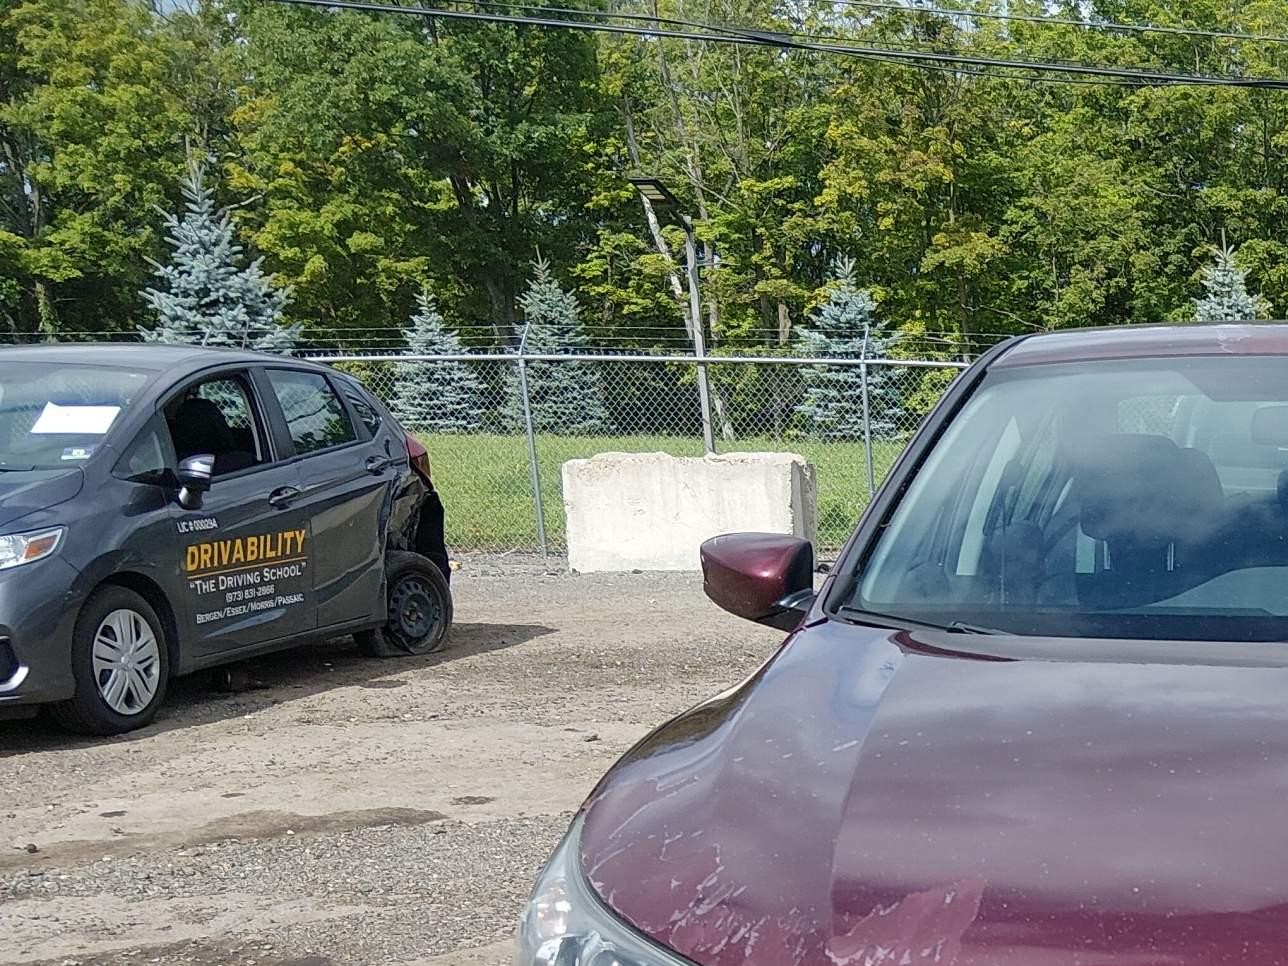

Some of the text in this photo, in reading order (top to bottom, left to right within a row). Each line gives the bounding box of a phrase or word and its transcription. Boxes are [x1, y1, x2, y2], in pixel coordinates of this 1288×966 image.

[186, 529, 306, 572] DRIVABILITY
[218, 571, 261, 591] DRIVING
[263, 561, 307, 582] SCHOOL"
[225, 590, 244, 603] (973)
